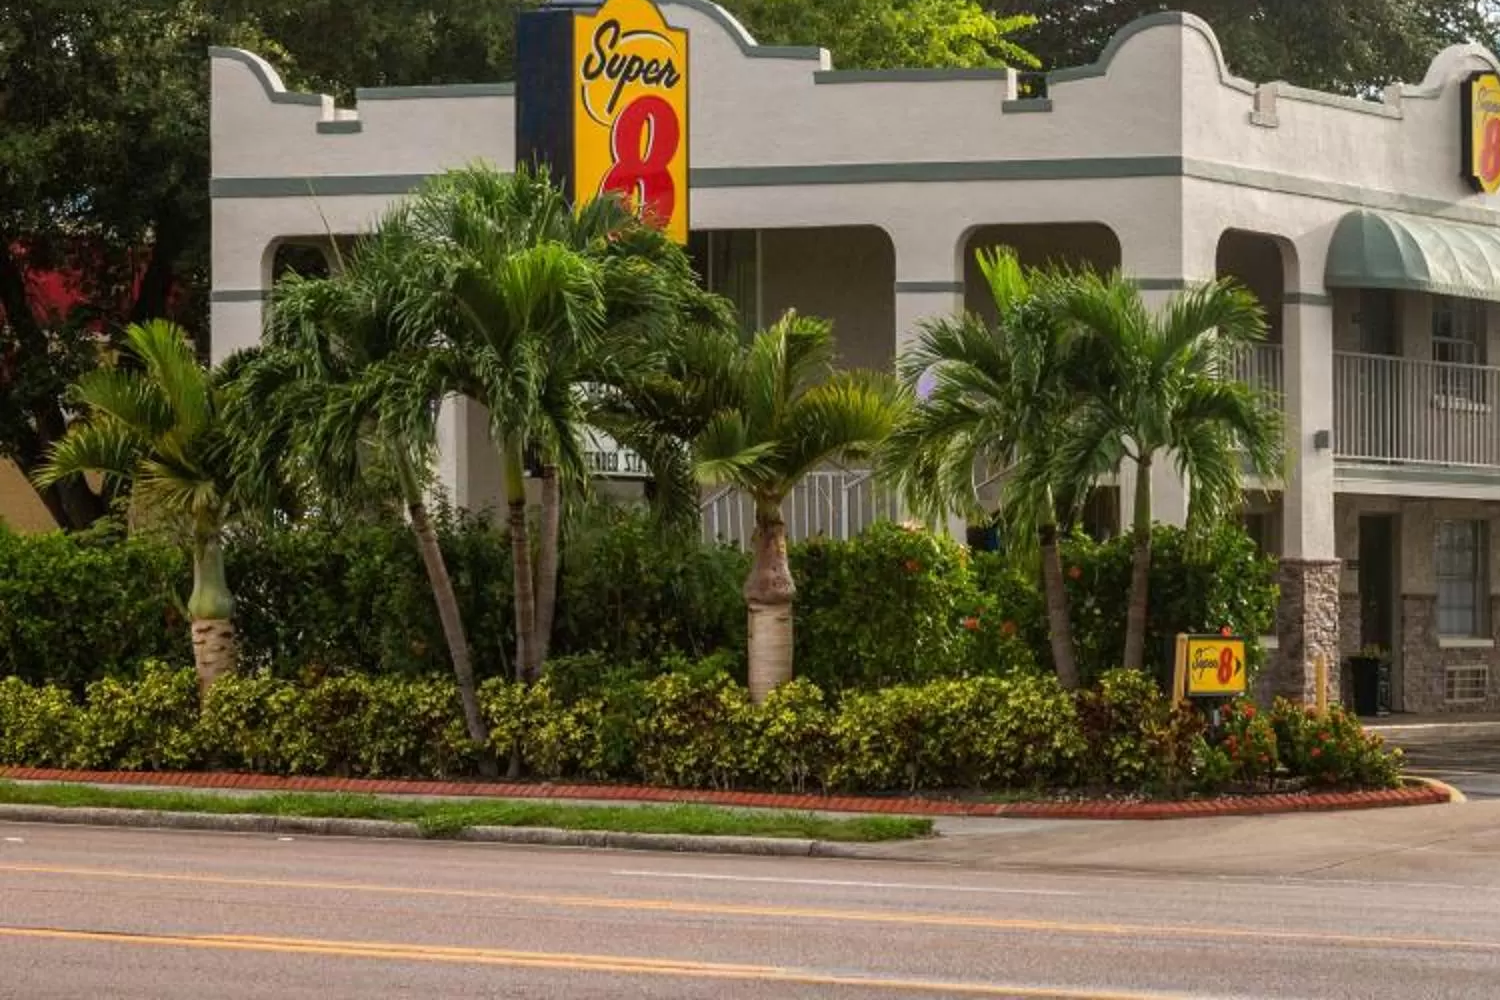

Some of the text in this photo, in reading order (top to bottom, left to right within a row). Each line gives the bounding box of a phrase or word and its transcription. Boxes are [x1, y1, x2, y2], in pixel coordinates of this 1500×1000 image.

[583, 19, 680, 114] Super
[599, 95, 681, 231] 8
[1217, 647, 1233, 684] 8
